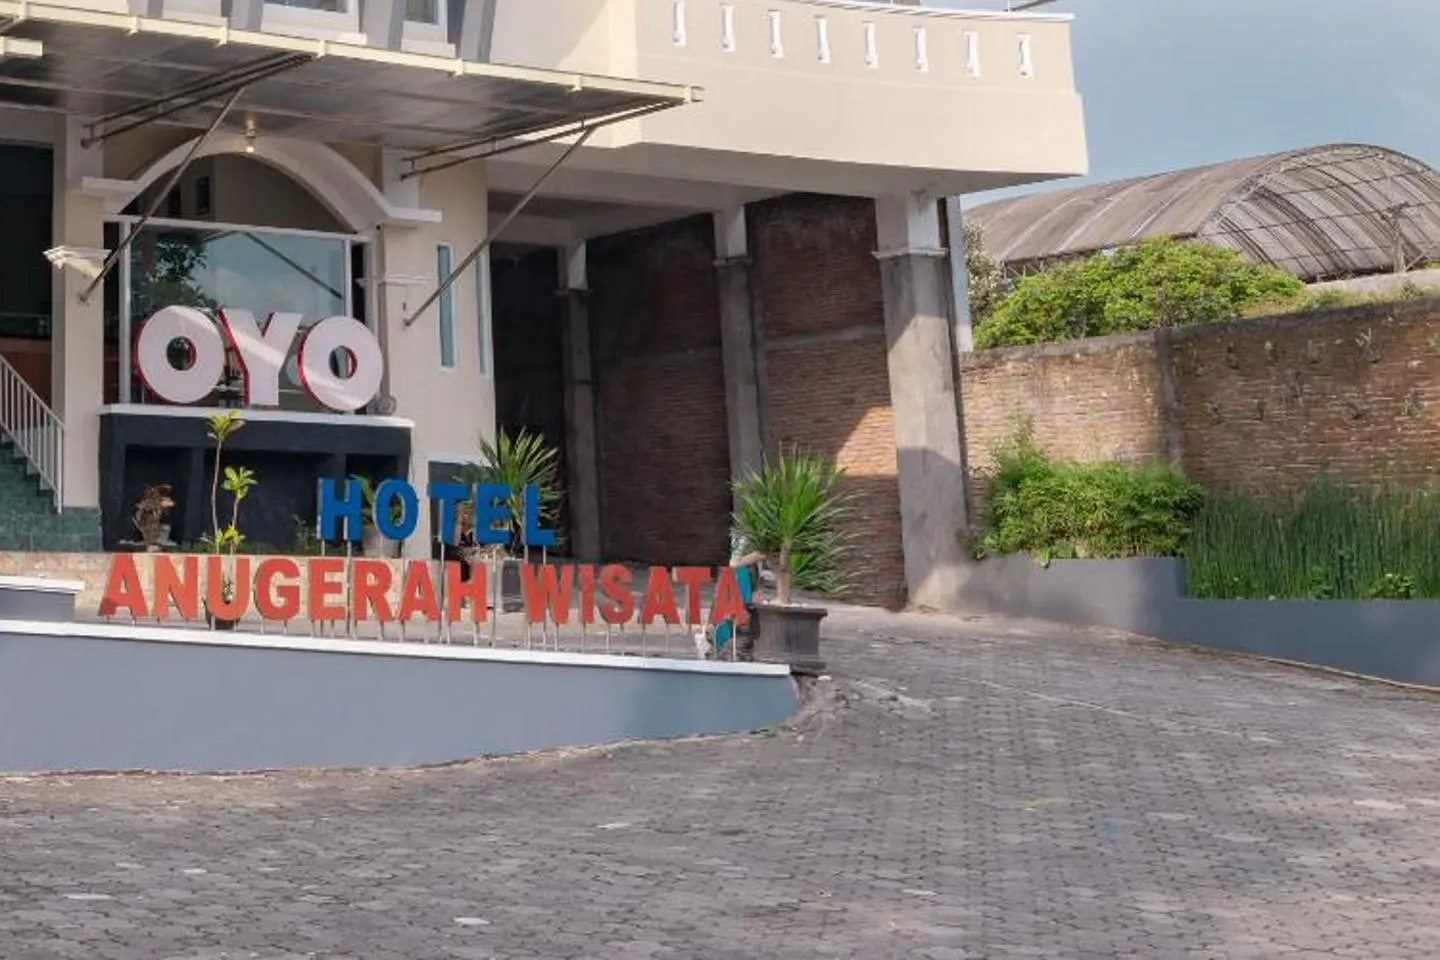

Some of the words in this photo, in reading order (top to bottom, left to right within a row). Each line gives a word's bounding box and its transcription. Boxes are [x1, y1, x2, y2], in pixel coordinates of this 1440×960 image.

[134, 304, 383, 412] OYO
[317, 476, 557, 546] HOTEL
[98, 553, 488, 622] ANUGERAH
[520, 563, 750, 626] WISATA
